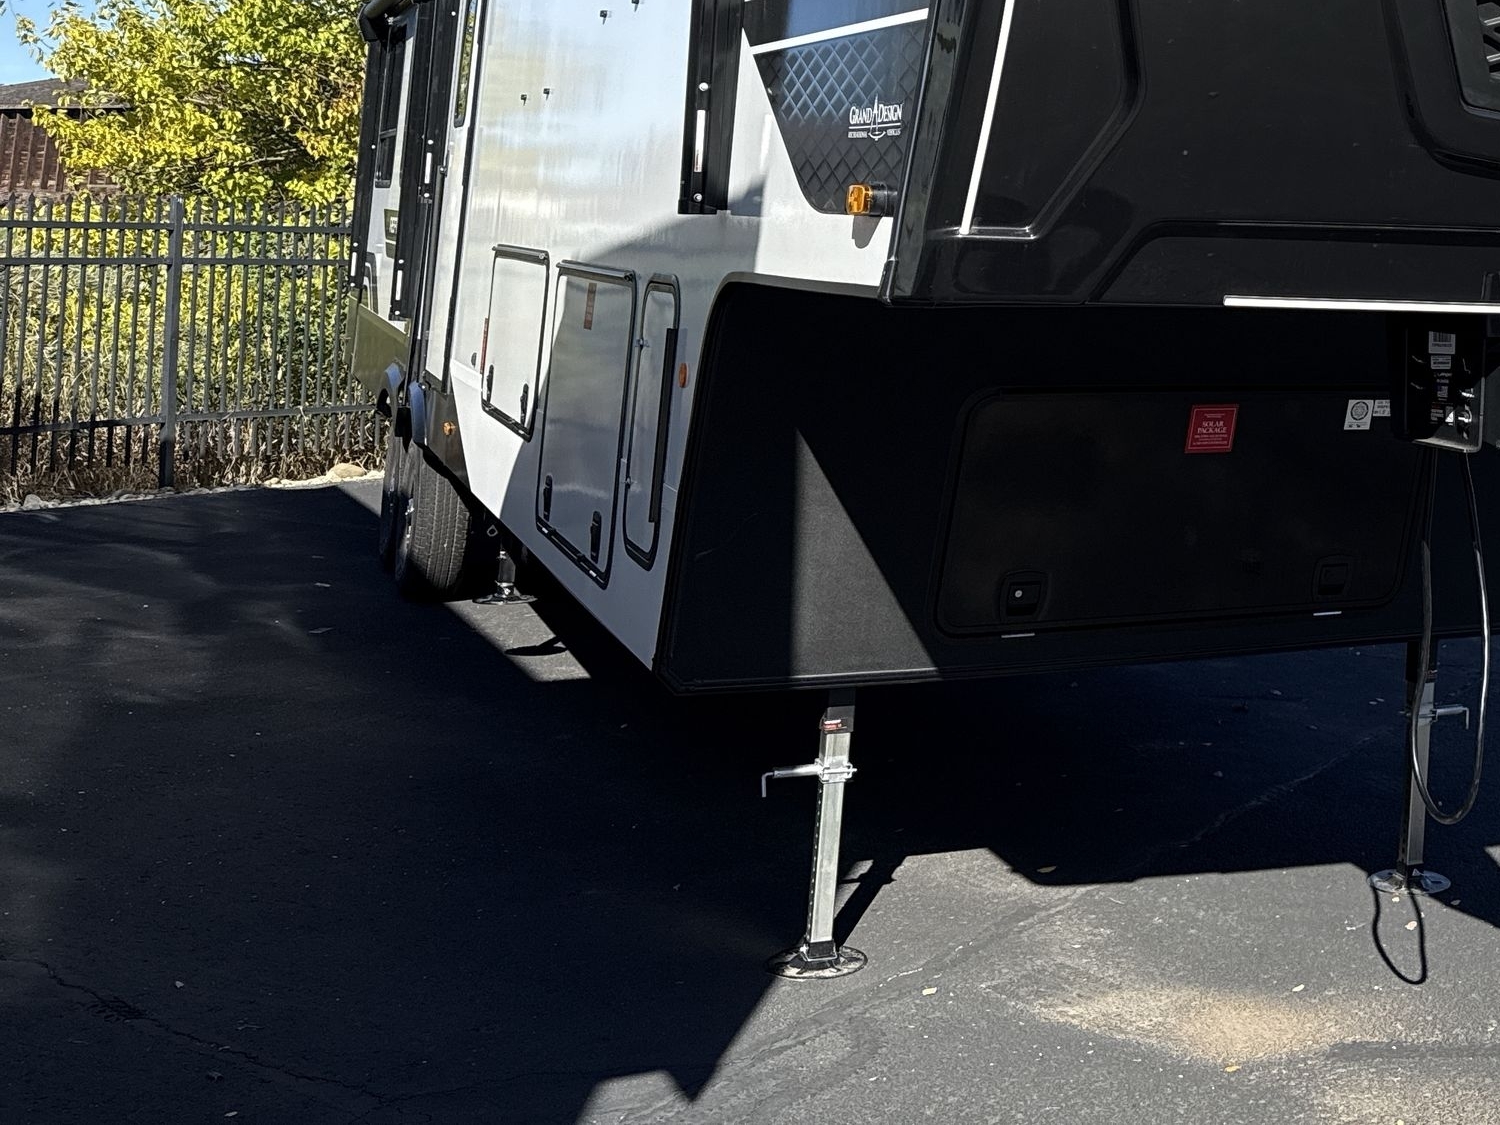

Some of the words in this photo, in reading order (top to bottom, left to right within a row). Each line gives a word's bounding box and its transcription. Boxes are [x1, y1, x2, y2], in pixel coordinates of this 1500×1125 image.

[849, 105, 873, 124] GRAND
[877, 103, 903, 122] DESIGN
[1202, 420, 1224, 428] SOLAR
